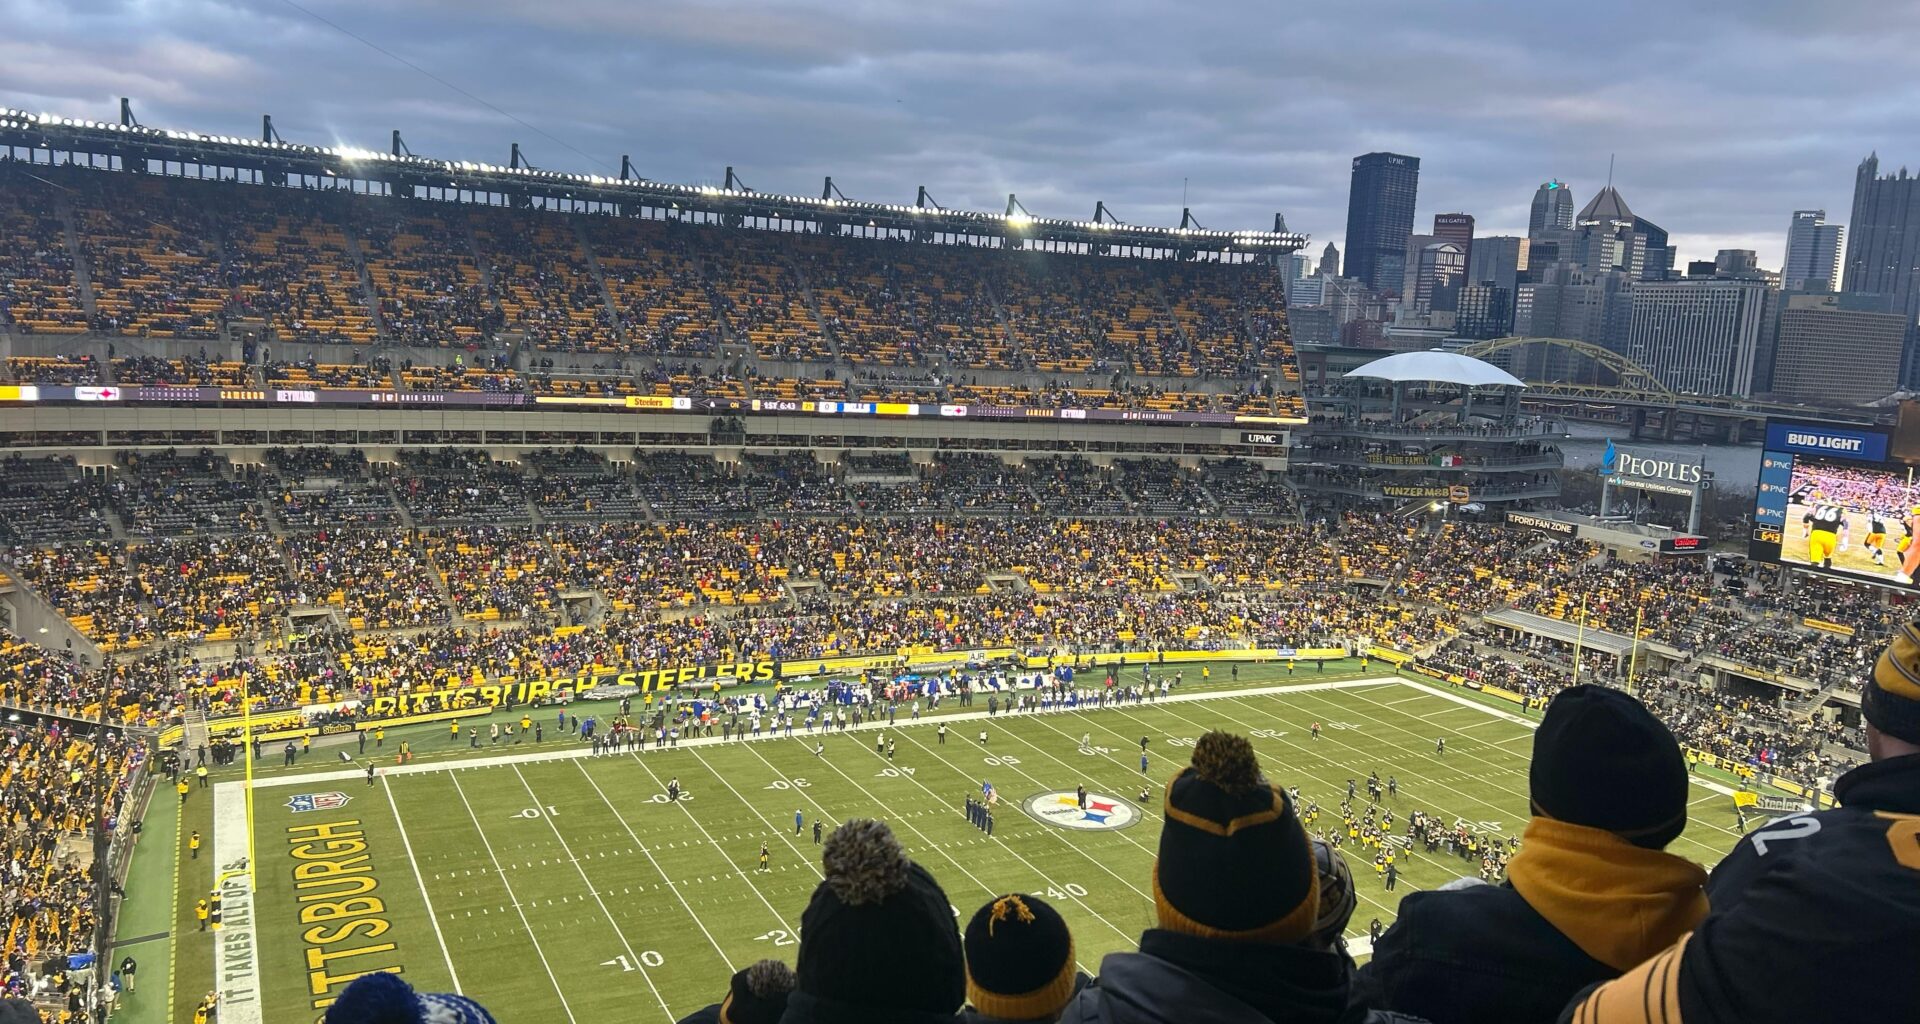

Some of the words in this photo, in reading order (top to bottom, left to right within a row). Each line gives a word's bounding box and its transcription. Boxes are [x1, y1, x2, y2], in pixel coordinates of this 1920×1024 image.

[1388, 157, 1405, 166] UPMC
[634, 397, 663, 407] Steelers
[779, 402, 796, 410] 6:43
[1248, 433, 1276, 444] UPMC
[1787, 433, 1818, 447] BUD
[1818, 436, 1862, 451] LIGHT
[1618, 453, 1702, 483] PEOPLES
[1773, 460, 1791, 470] PNC
[1383, 486, 1424, 497] YINZER
[1645, 482, 1666, 491] Utilities
[1666, 485, 1692, 496] Company
[1769, 484, 1787, 494] PNC
[1766, 508, 1784, 518] PNC
[1814, 505, 1839, 522] 66
[1514, 514, 1535, 526] FORD
[1535, 519, 1551, 529] FAN
[1550, 522, 1573, 534] ZONE
[322, 723, 352, 735] Steelers
[223, 901, 250, 927] ALL
[224, 932, 253, 982] TAKES
[225, 988, 255, 1005] IT
